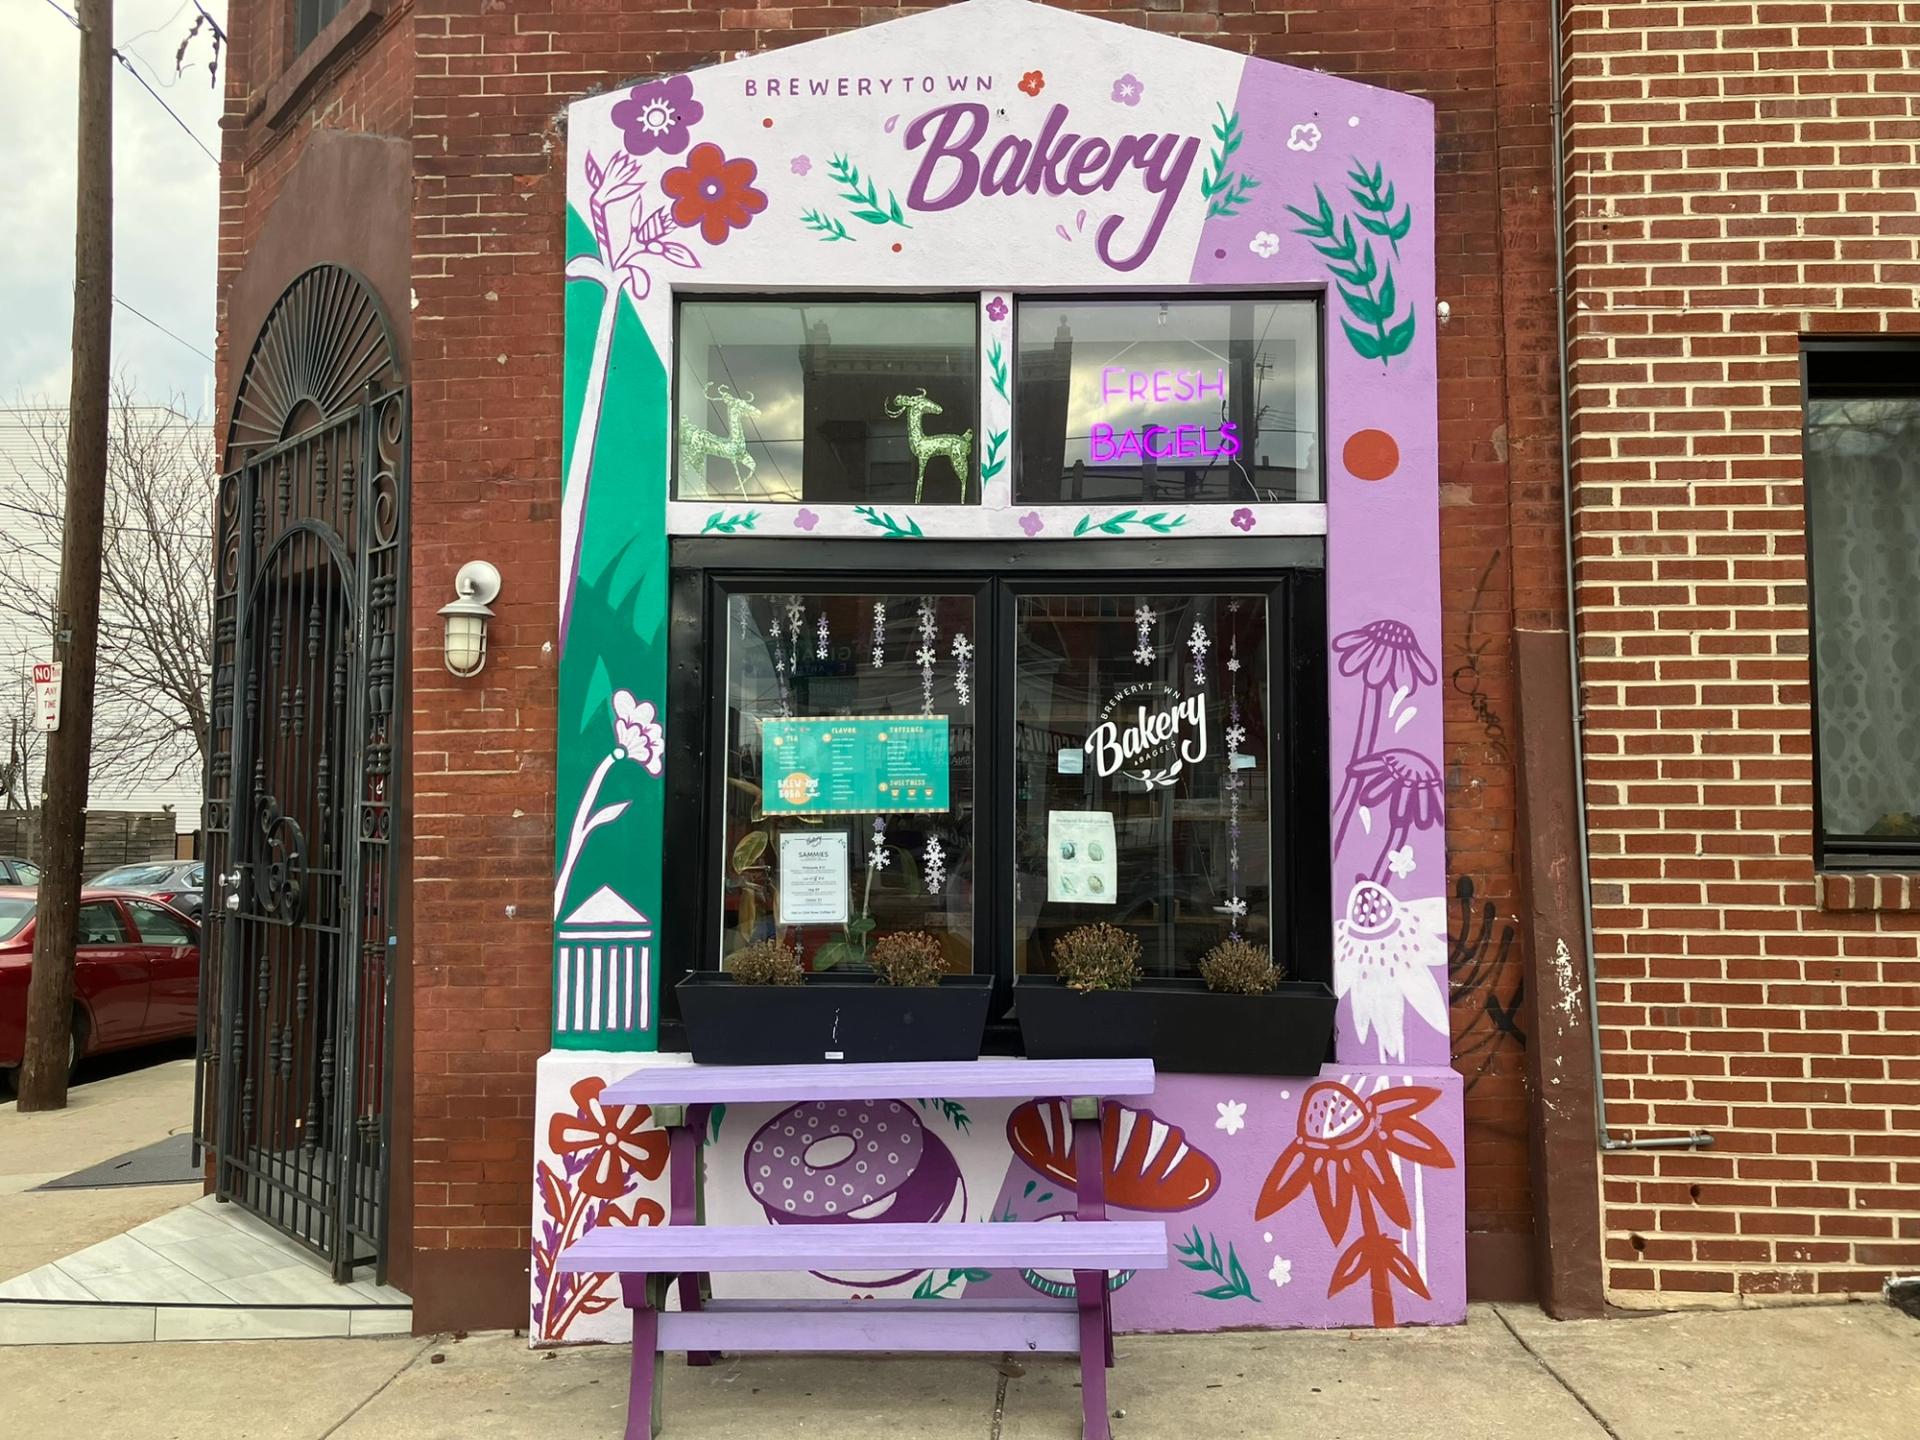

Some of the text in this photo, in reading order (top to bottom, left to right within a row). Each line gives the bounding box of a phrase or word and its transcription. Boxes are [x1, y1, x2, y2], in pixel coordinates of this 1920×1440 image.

[745, 75, 993, 96] BREWERYTOWN
[904, 103, 1200, 272] Bakery
[1102, 367, 1224, 403] FRESH
[1091, 422, 1241, 462] BAGELS
[35, 667, 50, 680] NO
[1101, 682, 1181, 720] BREWERYTWN
[1085, 693, 1207, 777] Bakery
[1139, 741, 1176, 763] BAGELS
